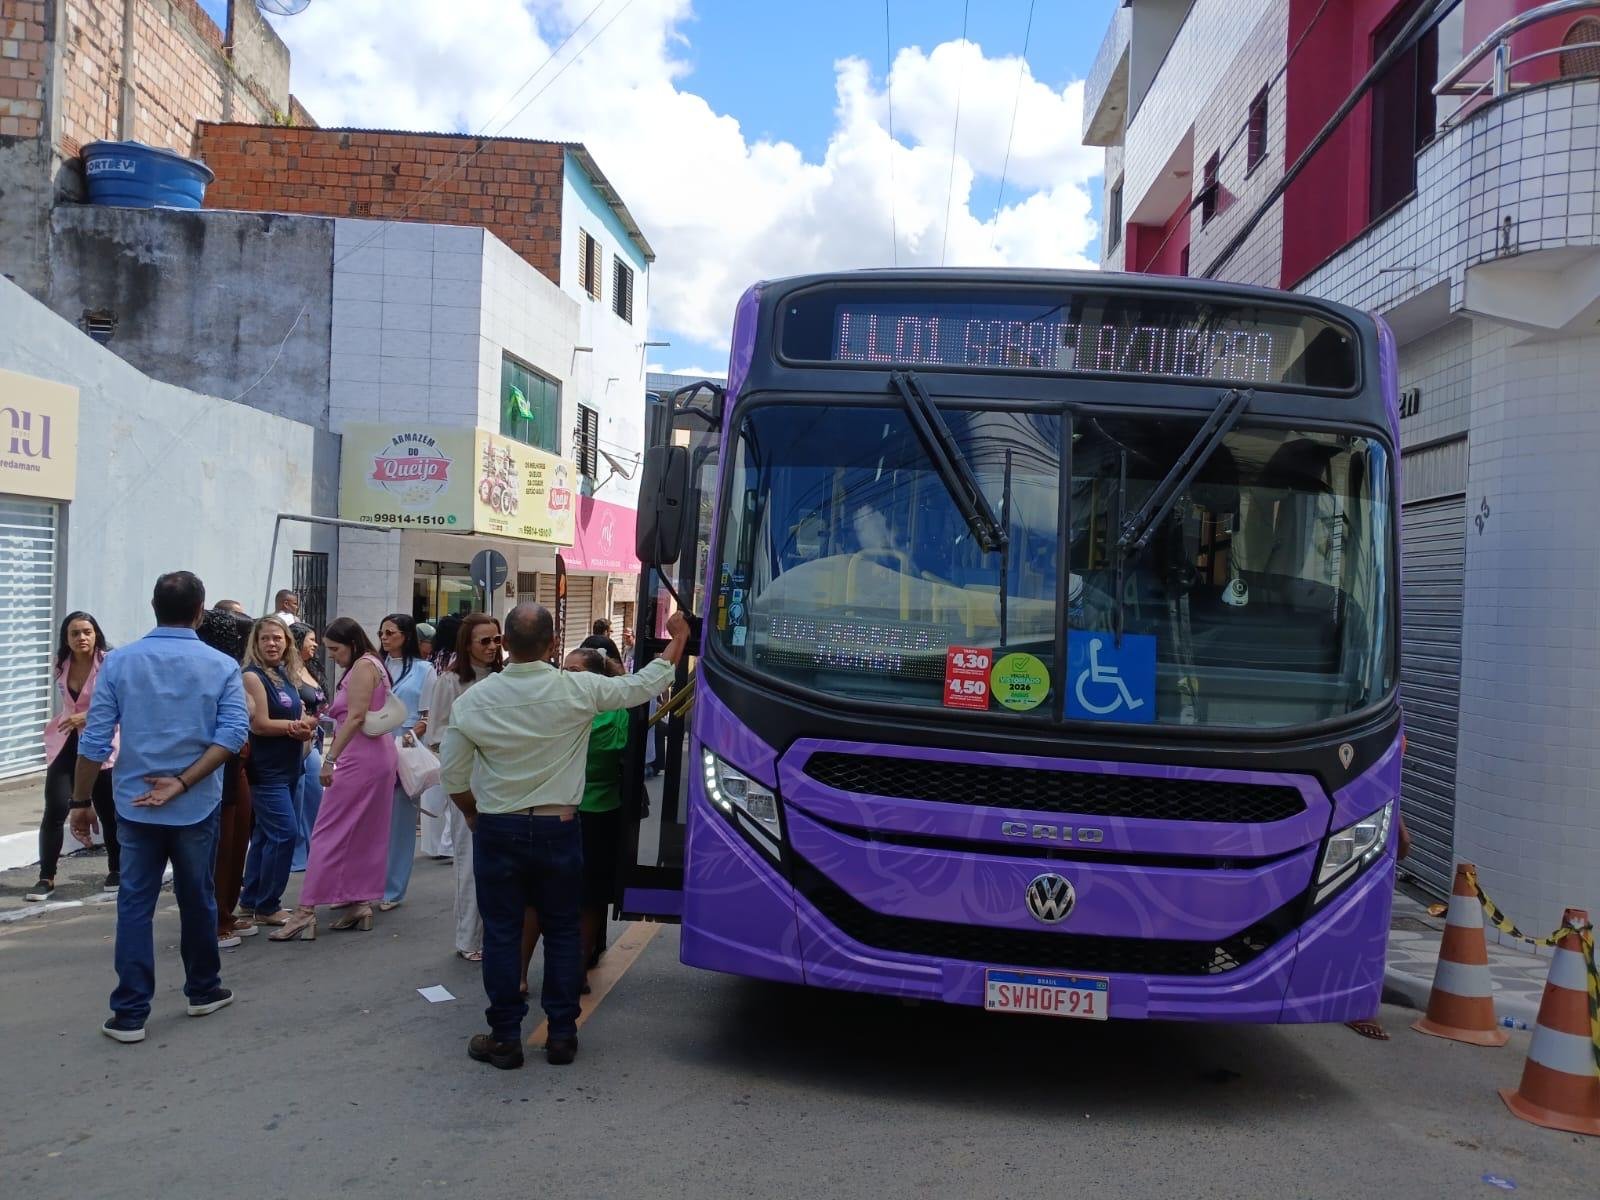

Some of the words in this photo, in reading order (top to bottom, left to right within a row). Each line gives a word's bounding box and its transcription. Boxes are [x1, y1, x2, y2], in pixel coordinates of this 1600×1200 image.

[87, 159, 129, 171] ORTLEV
[840, 313, 943, 364] LL01
[392, 433, 436, 448] ARMAZEM
[408, 448, 419, 456] DO
[384, 459, 438, 481] Queijo
[374, 513, 445, 525] 99814-1510
[952, 653, 989, 669] 4,30
[949, 678, 986, 695] 4,50
[1009, 683, 1031, 691] 2026
[1001, 821, 1104, 843] CAIO
